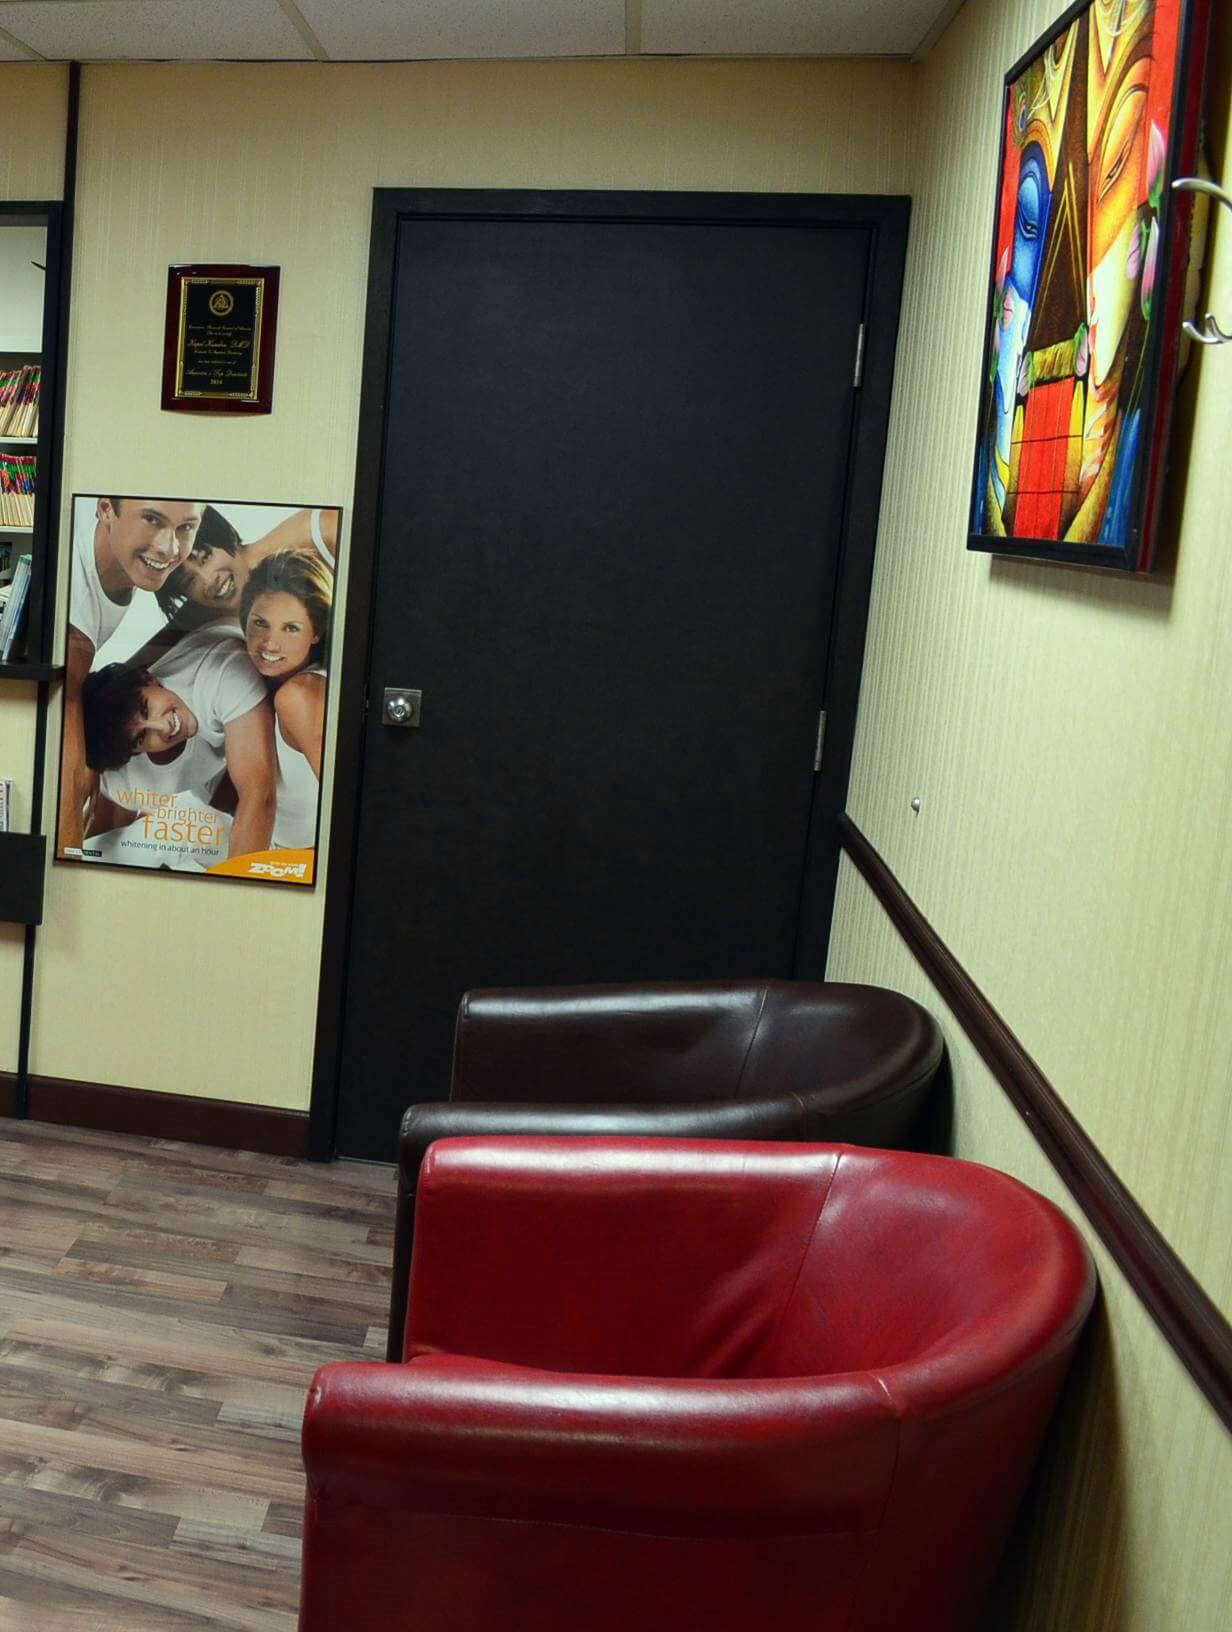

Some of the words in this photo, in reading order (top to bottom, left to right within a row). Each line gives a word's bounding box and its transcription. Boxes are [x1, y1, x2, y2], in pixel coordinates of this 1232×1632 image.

[118, 787, 178, 807] whiter
[157, 805, 219, 824] brighter
[144, 813, 224, 845] faster
[120, 840, 157, 851] whitening
[159, 842, 167, 850] in
[168, 844, 189, 853] about
[201, 847, 220, 856] hour
